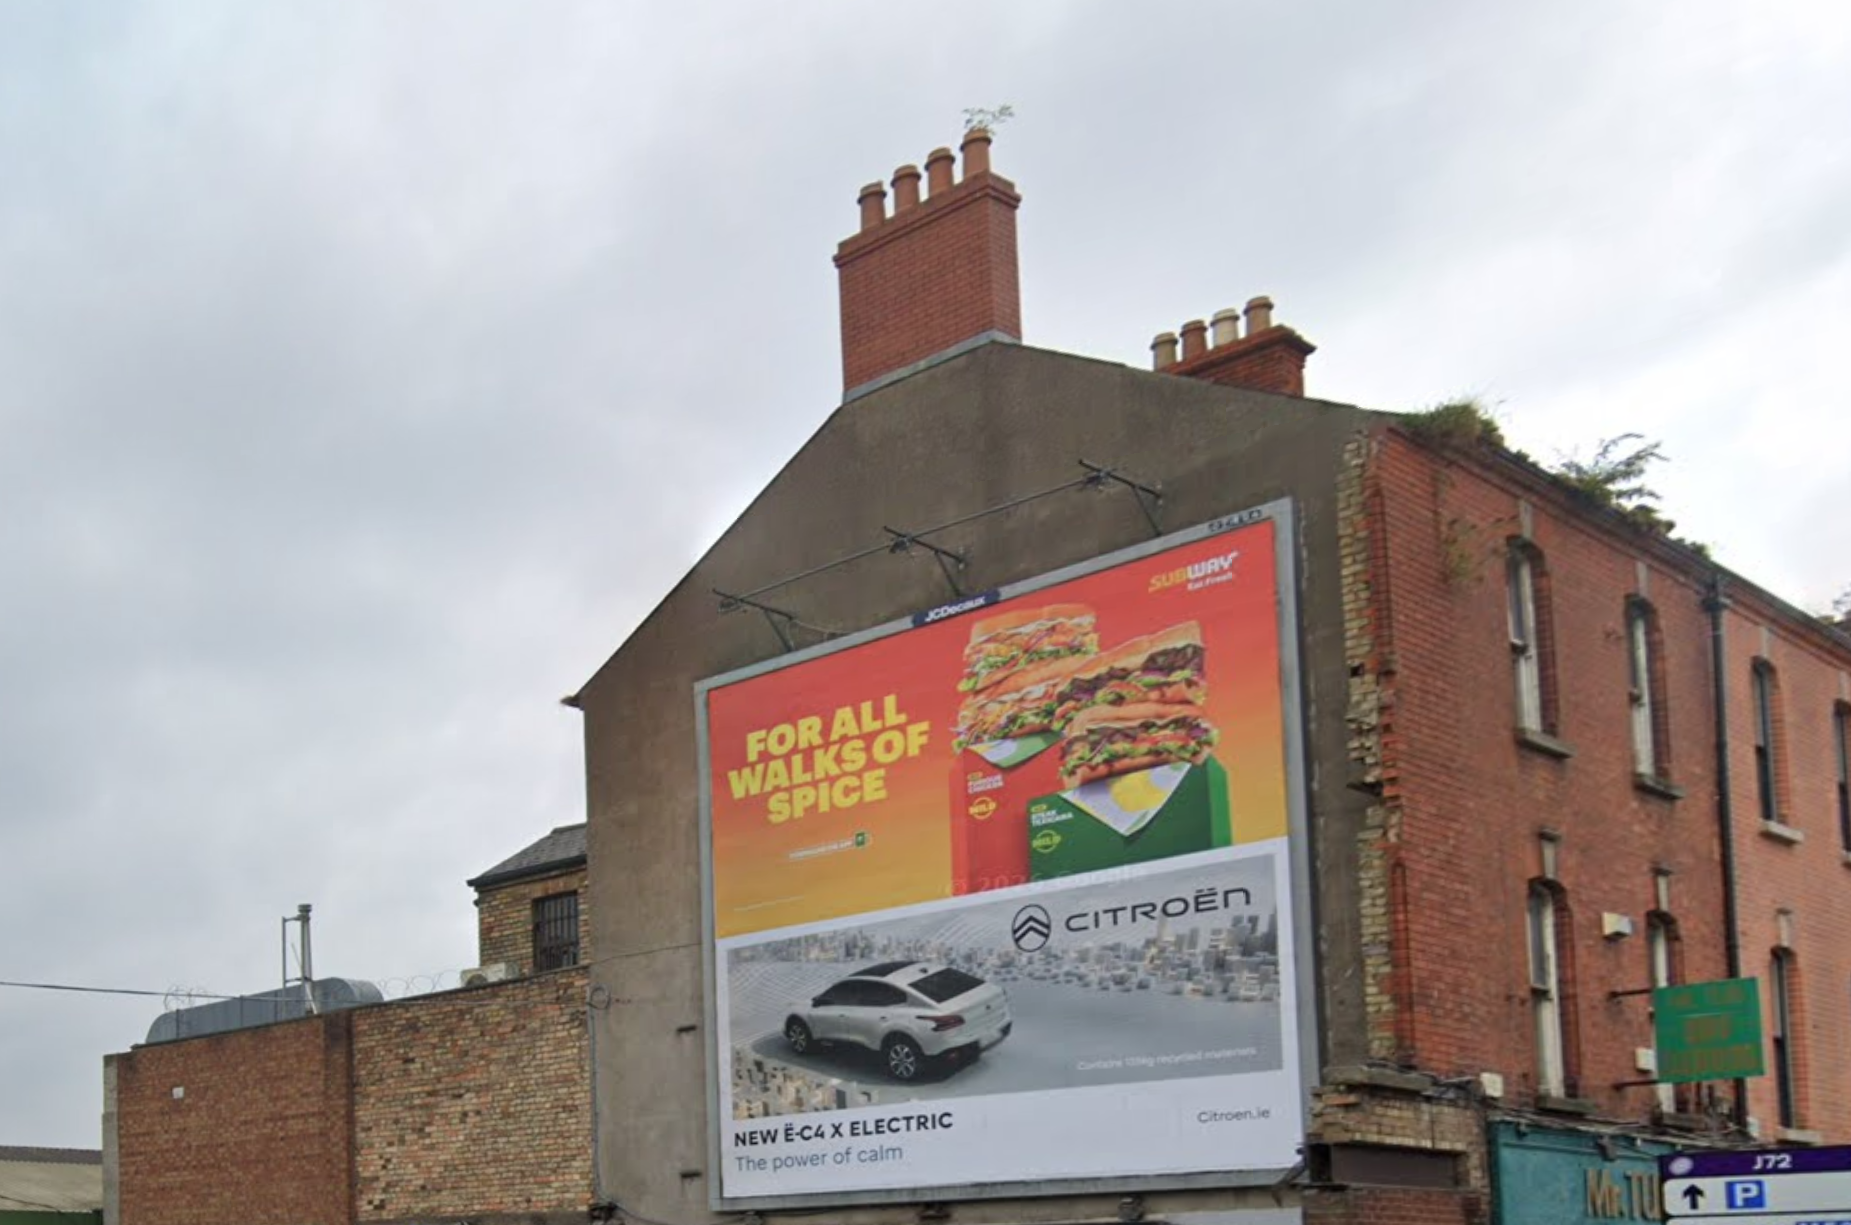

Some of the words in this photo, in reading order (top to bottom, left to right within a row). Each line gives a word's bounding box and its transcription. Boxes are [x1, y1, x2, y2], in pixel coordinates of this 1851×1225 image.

[1148, 551, 1239, 594] SUBWAY
[924, 596, 986, 622] JCDecaux
[746, 716, 824, 763] FOR
[829, 693, 908, 742] ALL
[727, 738, 867, 800] WALKS
[871, 721, 931, 764] OF
[767, 768, 888, 824] SPICE
[734, 1128, 779, 1147] NEW
[784, 1122, 826, 1143] Ë-C4
[830, 1122, 844, 1139] X
[849, 1111, 954, 1137] ELECTRIC
[1197, 1107, 1271, 1124] Citroen.ie
[735, 1156, 767, 1172] The
[772, 1151, 827, 1173] power
[833, 1147, 852, 1165] of
[857, 1144, 904, 1163] calm
[1752, 1153, 1793, 1170] J72
[1733, 1182, 1760, 1207] P
